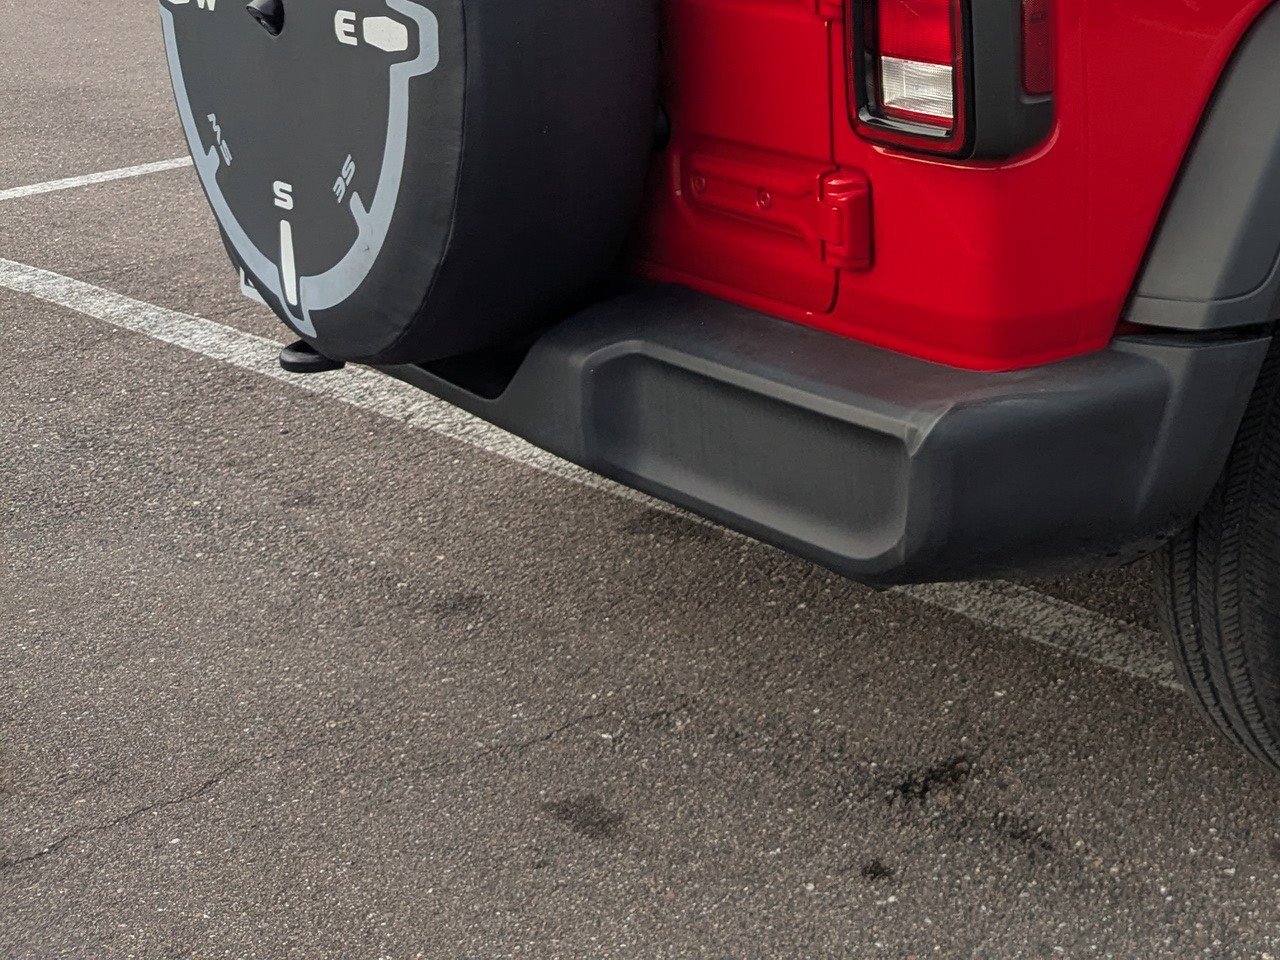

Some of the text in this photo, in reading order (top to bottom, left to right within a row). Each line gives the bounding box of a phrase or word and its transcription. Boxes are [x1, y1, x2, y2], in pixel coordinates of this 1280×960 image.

[334, 10, 358, 46] E
[207, 113, 233, 167] SW
[273, 180, 294, 211] S
[332, 154, 356, 204] SE
